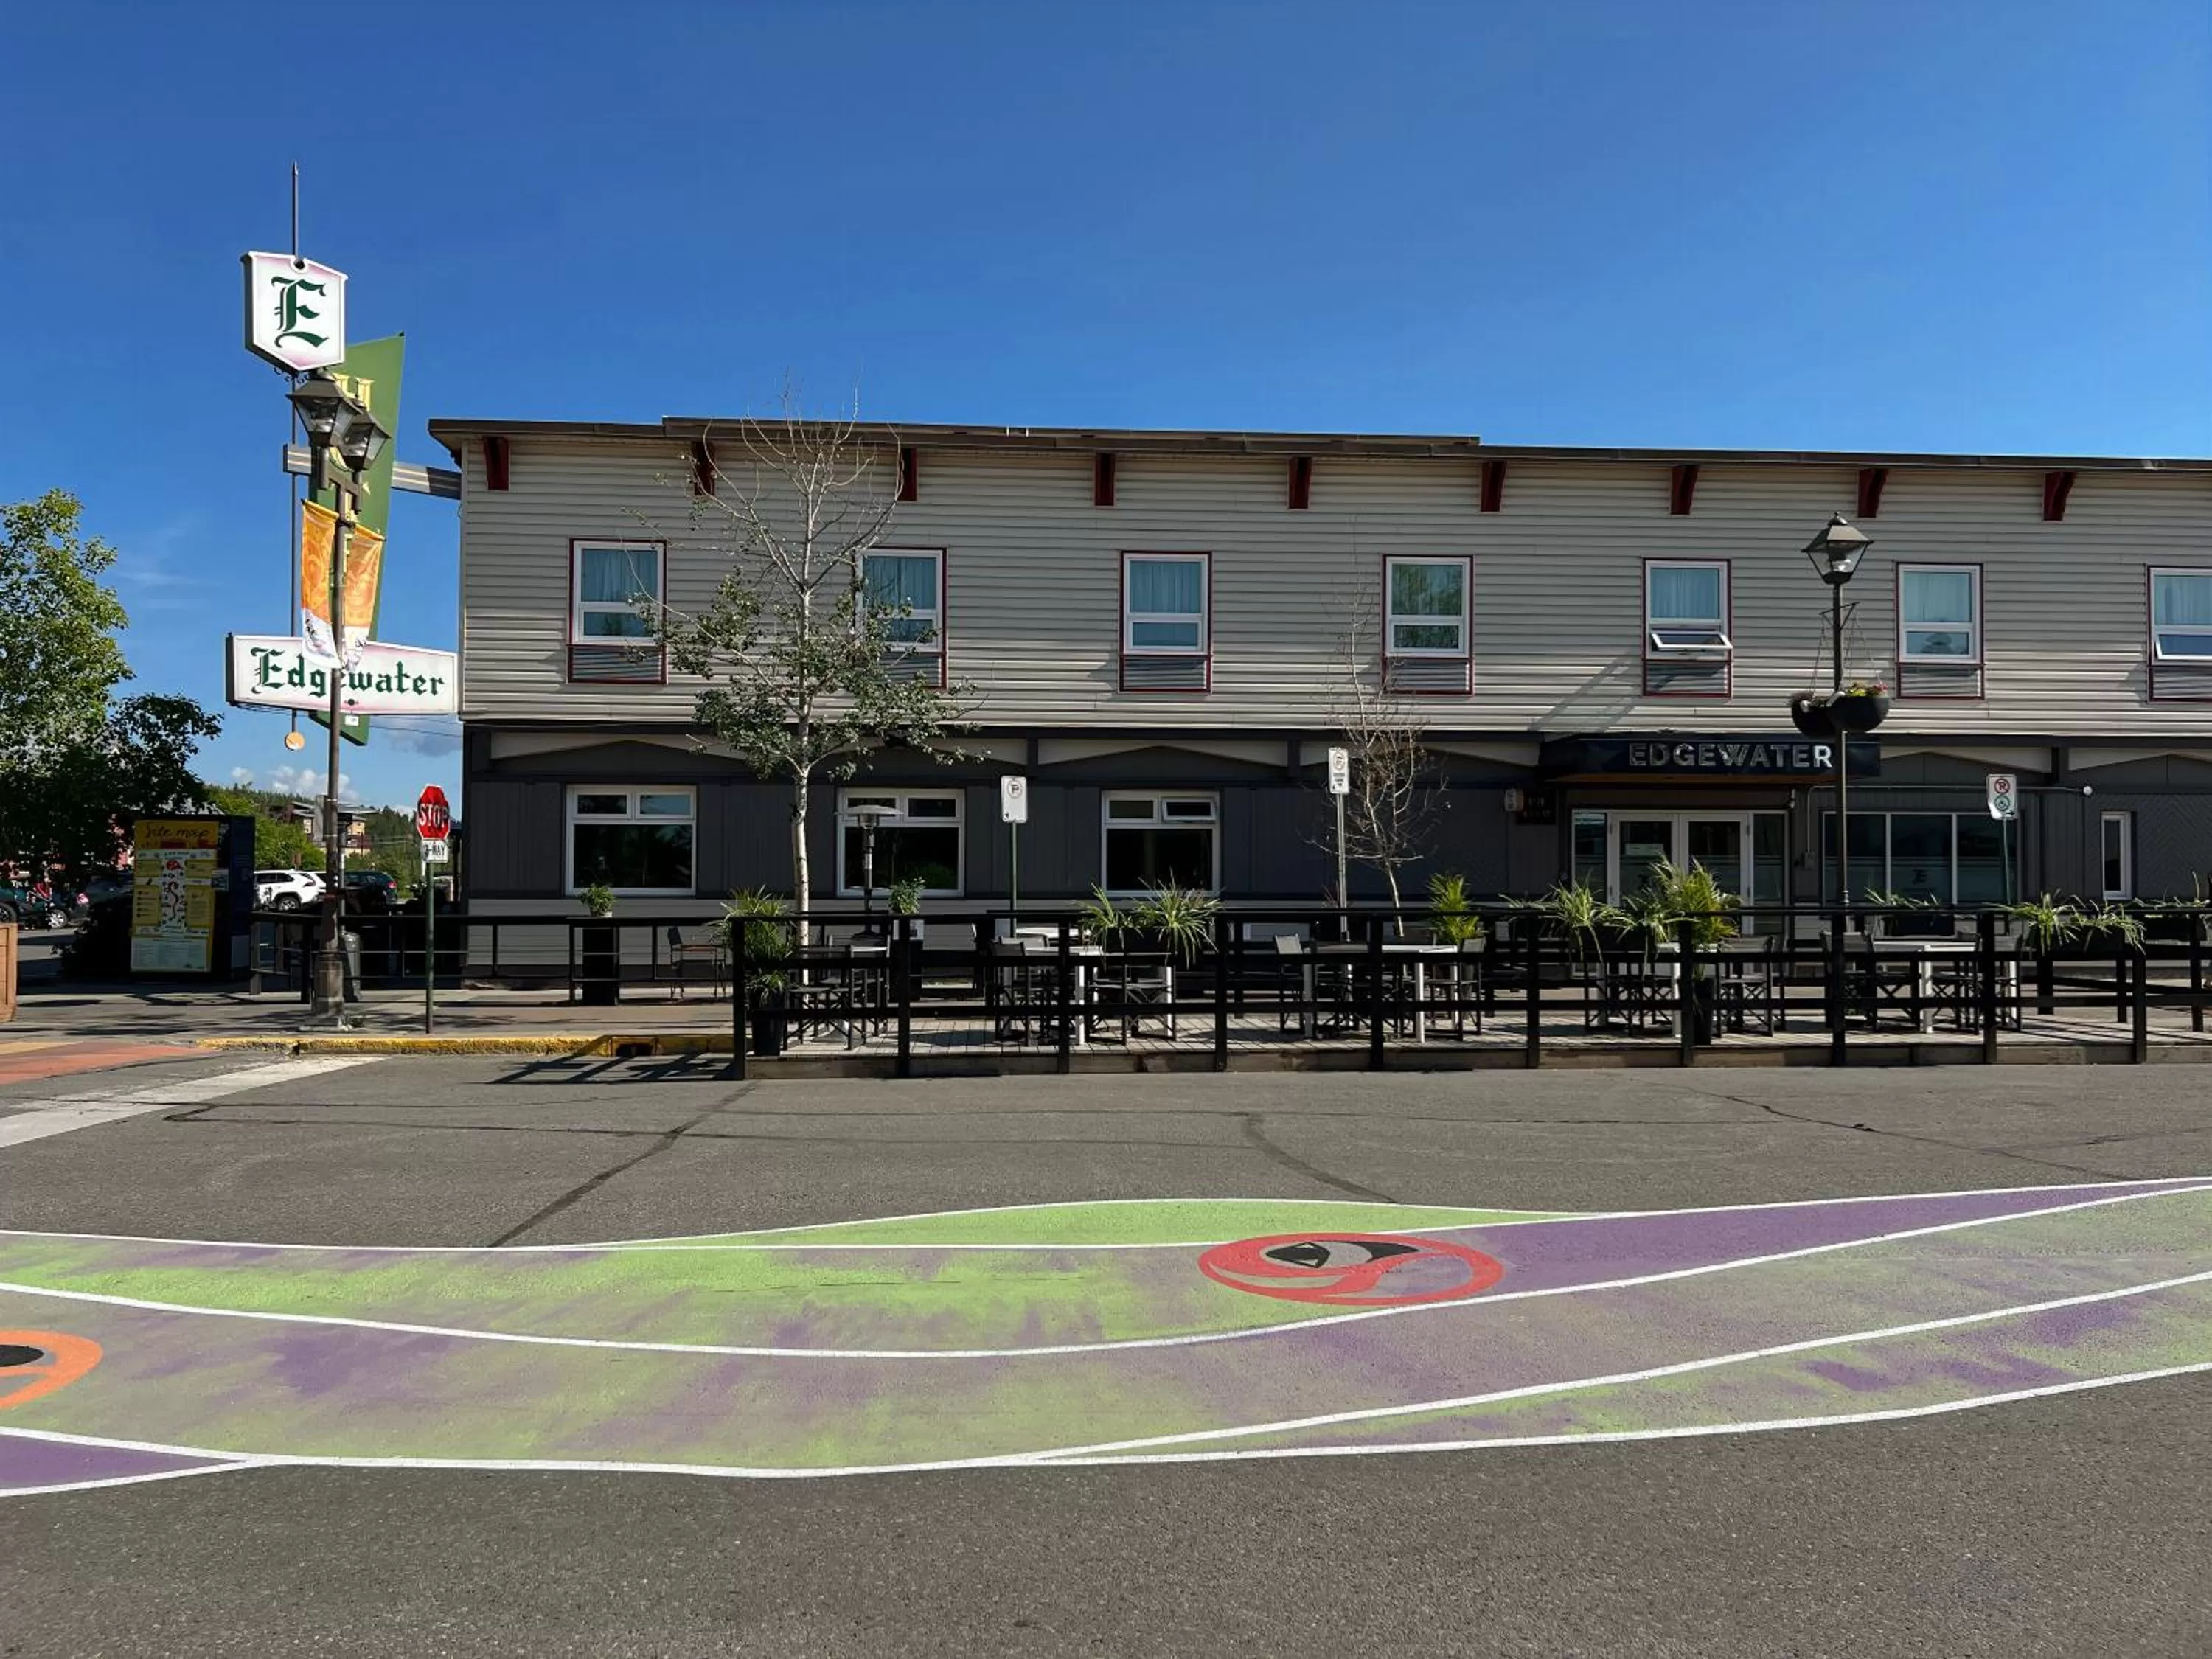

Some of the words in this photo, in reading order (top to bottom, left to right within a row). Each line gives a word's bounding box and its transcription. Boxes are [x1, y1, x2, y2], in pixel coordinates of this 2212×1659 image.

[271, 275, 329, 348] E
[1628, 742, 1833, 769] EDGEWATER
[419, 802, 448, 828] STOP
